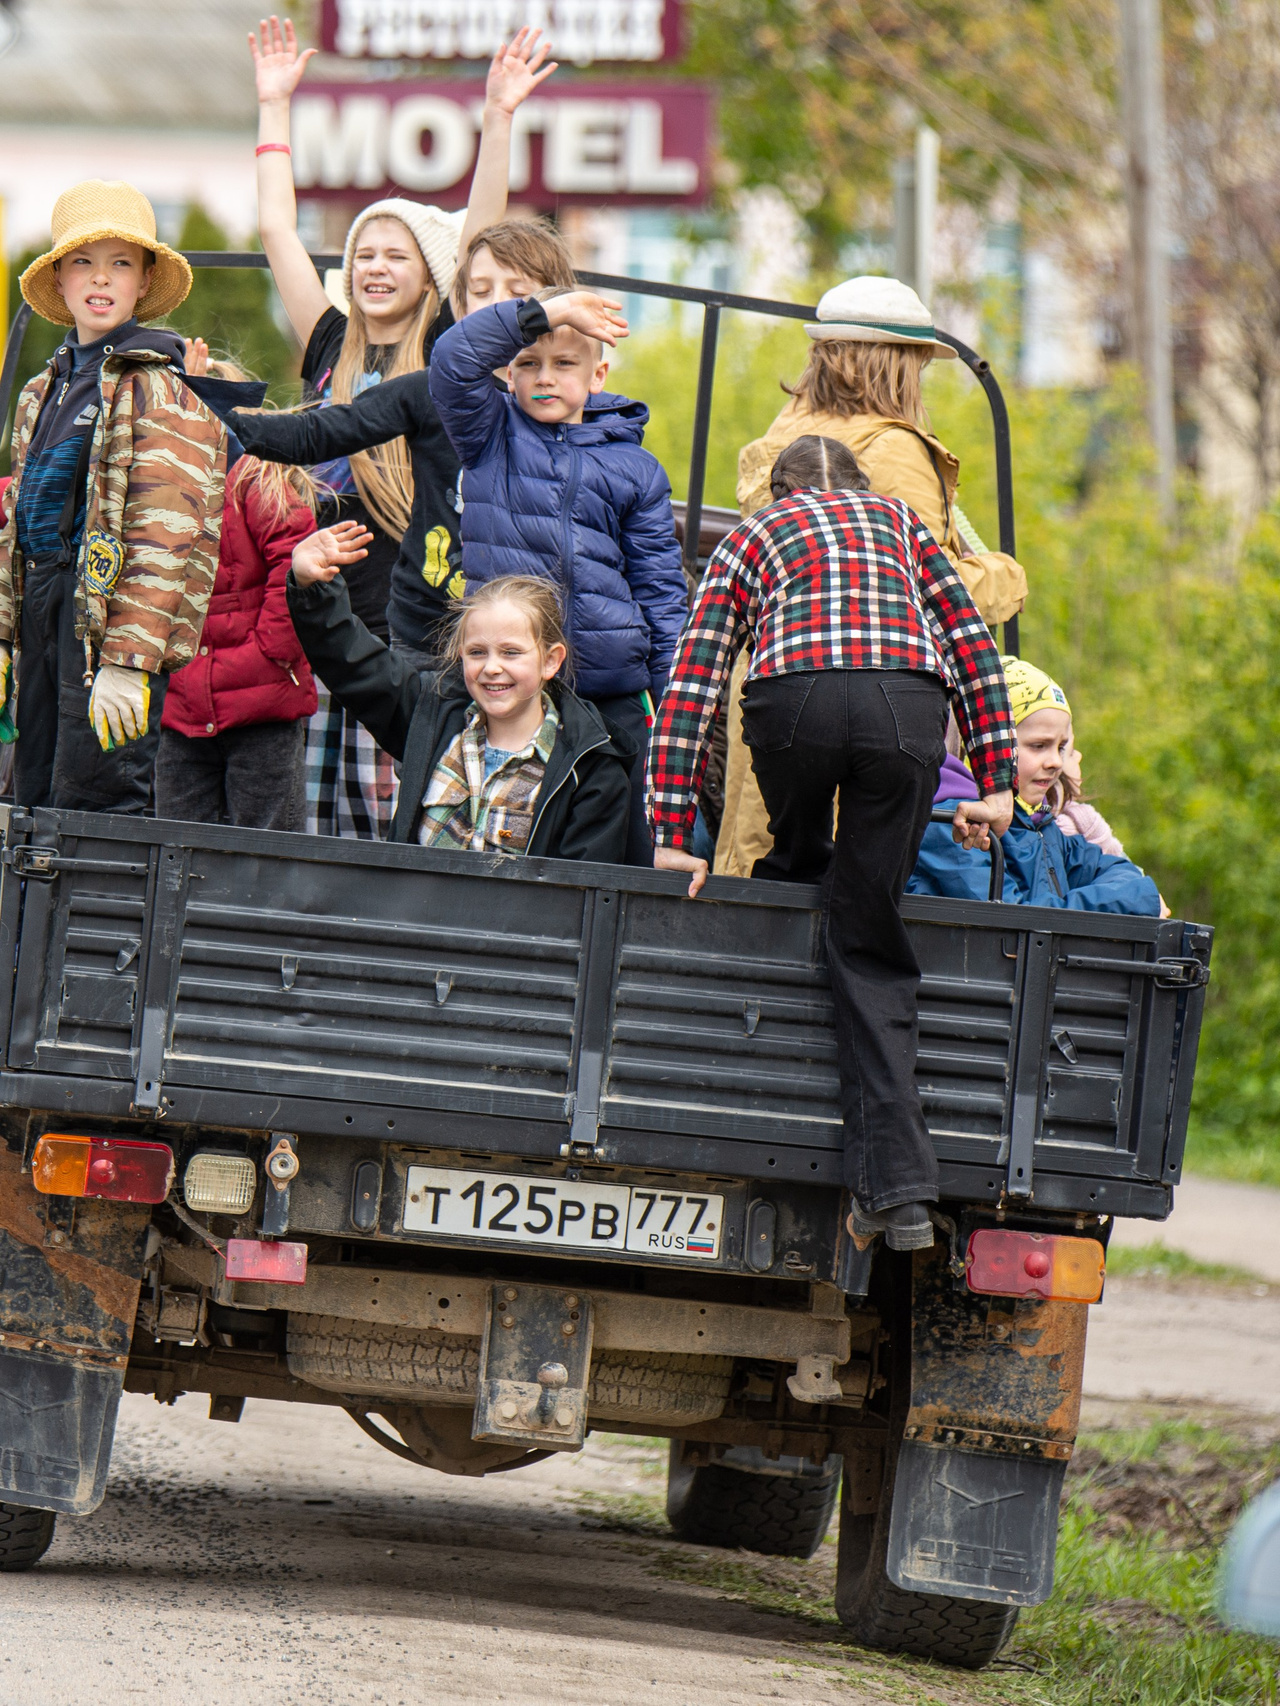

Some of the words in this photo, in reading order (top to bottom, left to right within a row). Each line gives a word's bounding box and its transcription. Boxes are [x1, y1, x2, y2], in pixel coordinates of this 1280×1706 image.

[291, 93, 698, 194] MOTEL
[634, 1192, 709, 1235] 777
[648, 1233, 685, 1249] RUS
